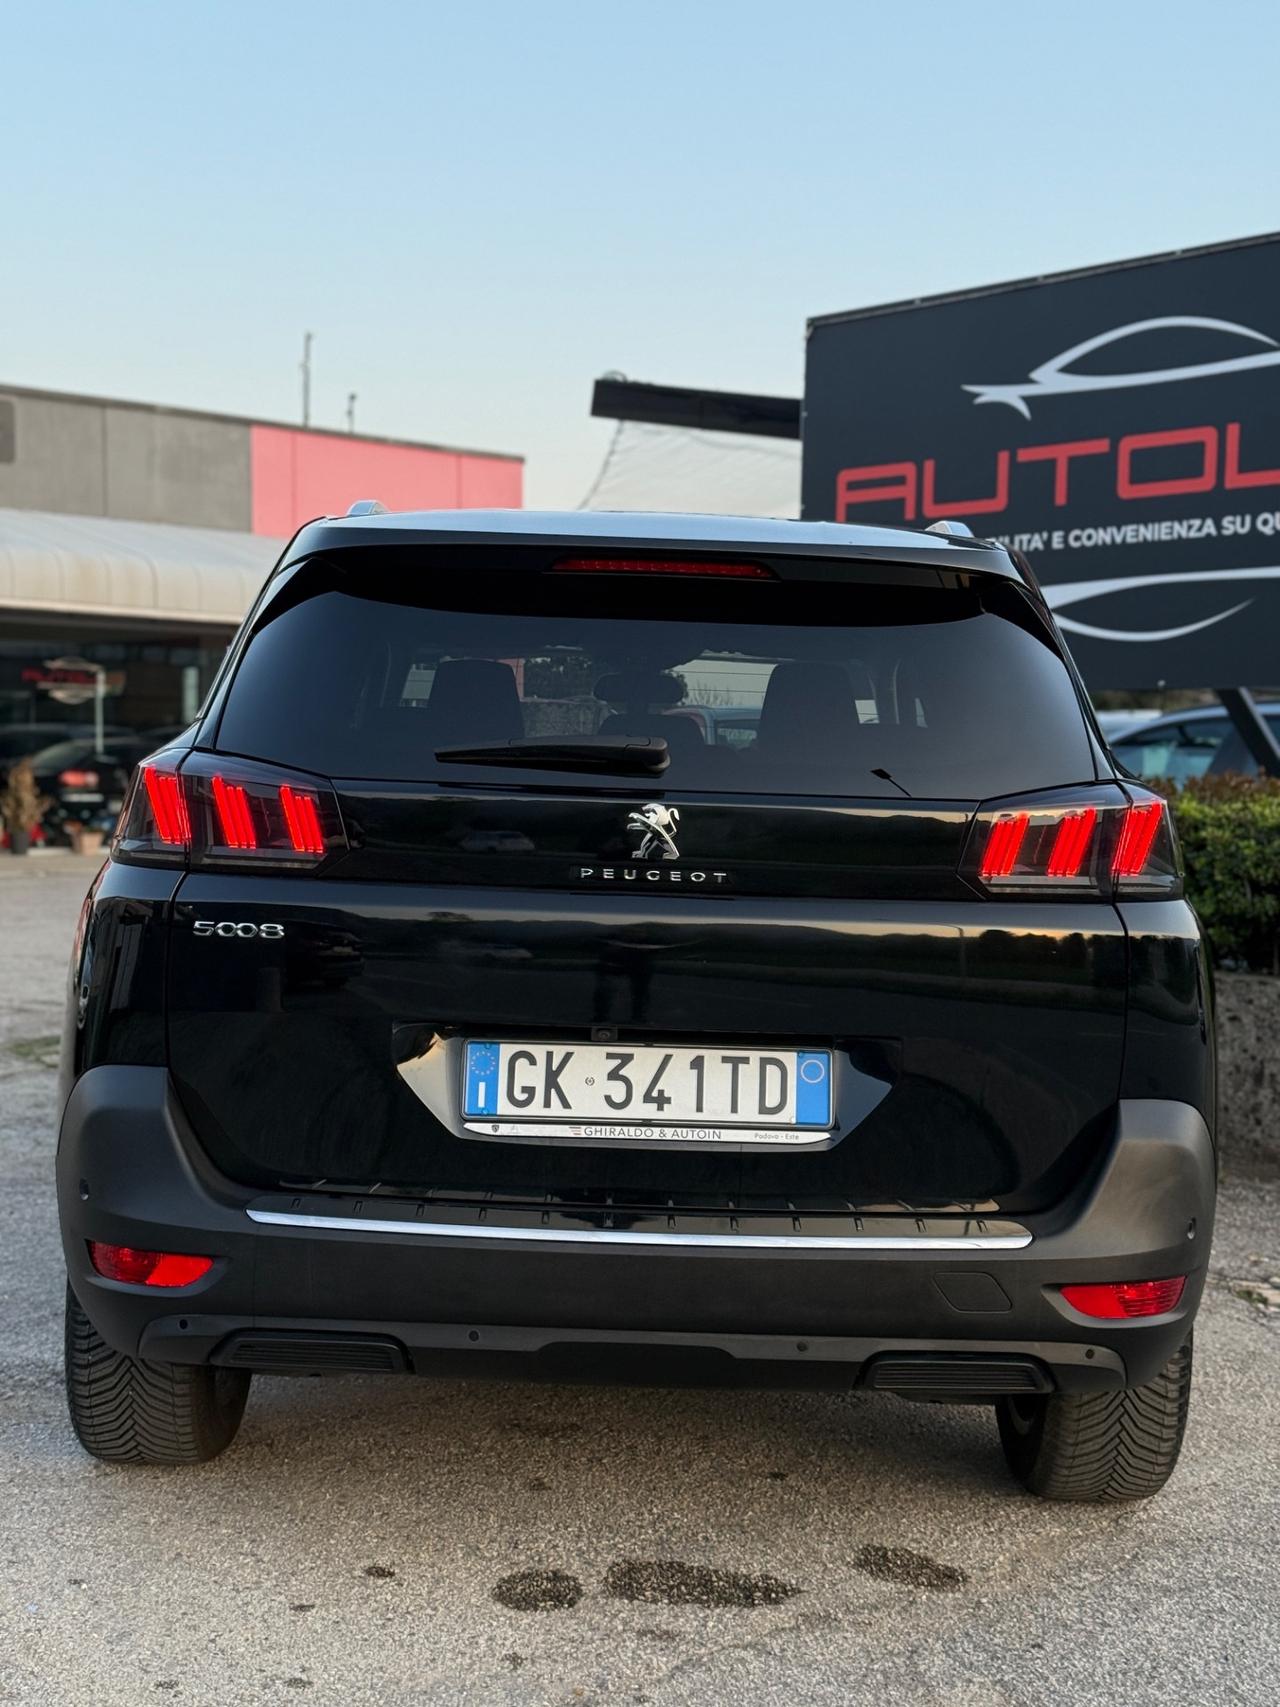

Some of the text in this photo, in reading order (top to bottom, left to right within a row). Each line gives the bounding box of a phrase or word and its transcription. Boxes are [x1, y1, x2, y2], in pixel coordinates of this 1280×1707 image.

[836, 422, 1280, 522] AUTOL
[1051, 530, 1065, 550] E
[1068, 517, 1218, 549] CONVENIENZA
[1221, 514, 1251, 536] SU
[580, 868, 727, 884] PEUGEOT
[193, 921, 285, 939] 5008
[584, 1126, 722, 1140] GHIRALDO & AUTOIN
